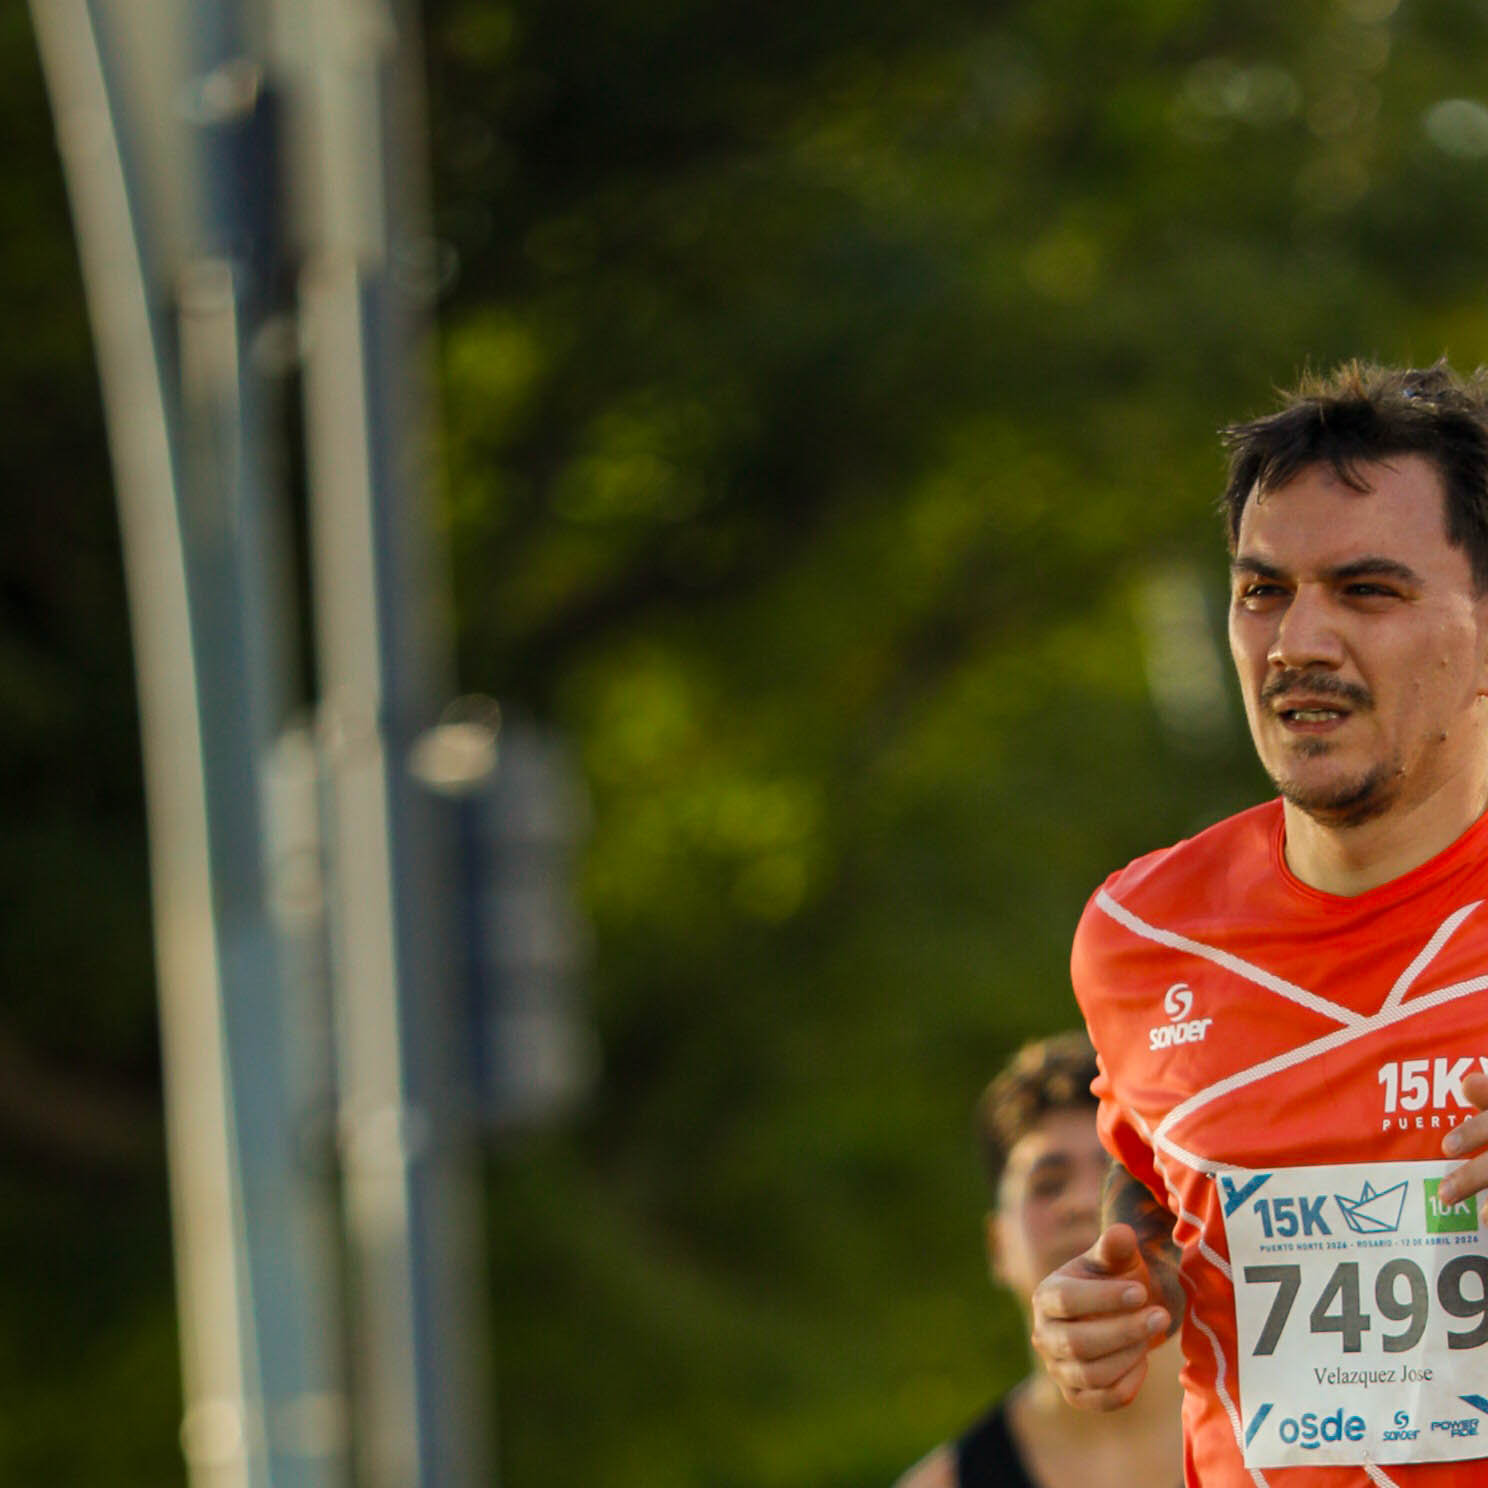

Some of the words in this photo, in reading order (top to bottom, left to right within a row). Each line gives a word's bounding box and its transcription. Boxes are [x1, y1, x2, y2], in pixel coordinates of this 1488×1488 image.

[1378, 1057, 1474, 1113] 15K
[1253, 1195, 1332, 1238] 15K
[1297, 1242, 1323, 1251] NORTE
[1357, 1239, 1392, 1248] ROSARIO
[1425, 1237, 1450, 1246] ABRIL
[1313, 1366, 1396, 1388] Velazquez
[1400, 1364, 1433, 1383] Jose
[1279, 1408, 1366, 1445] osde
